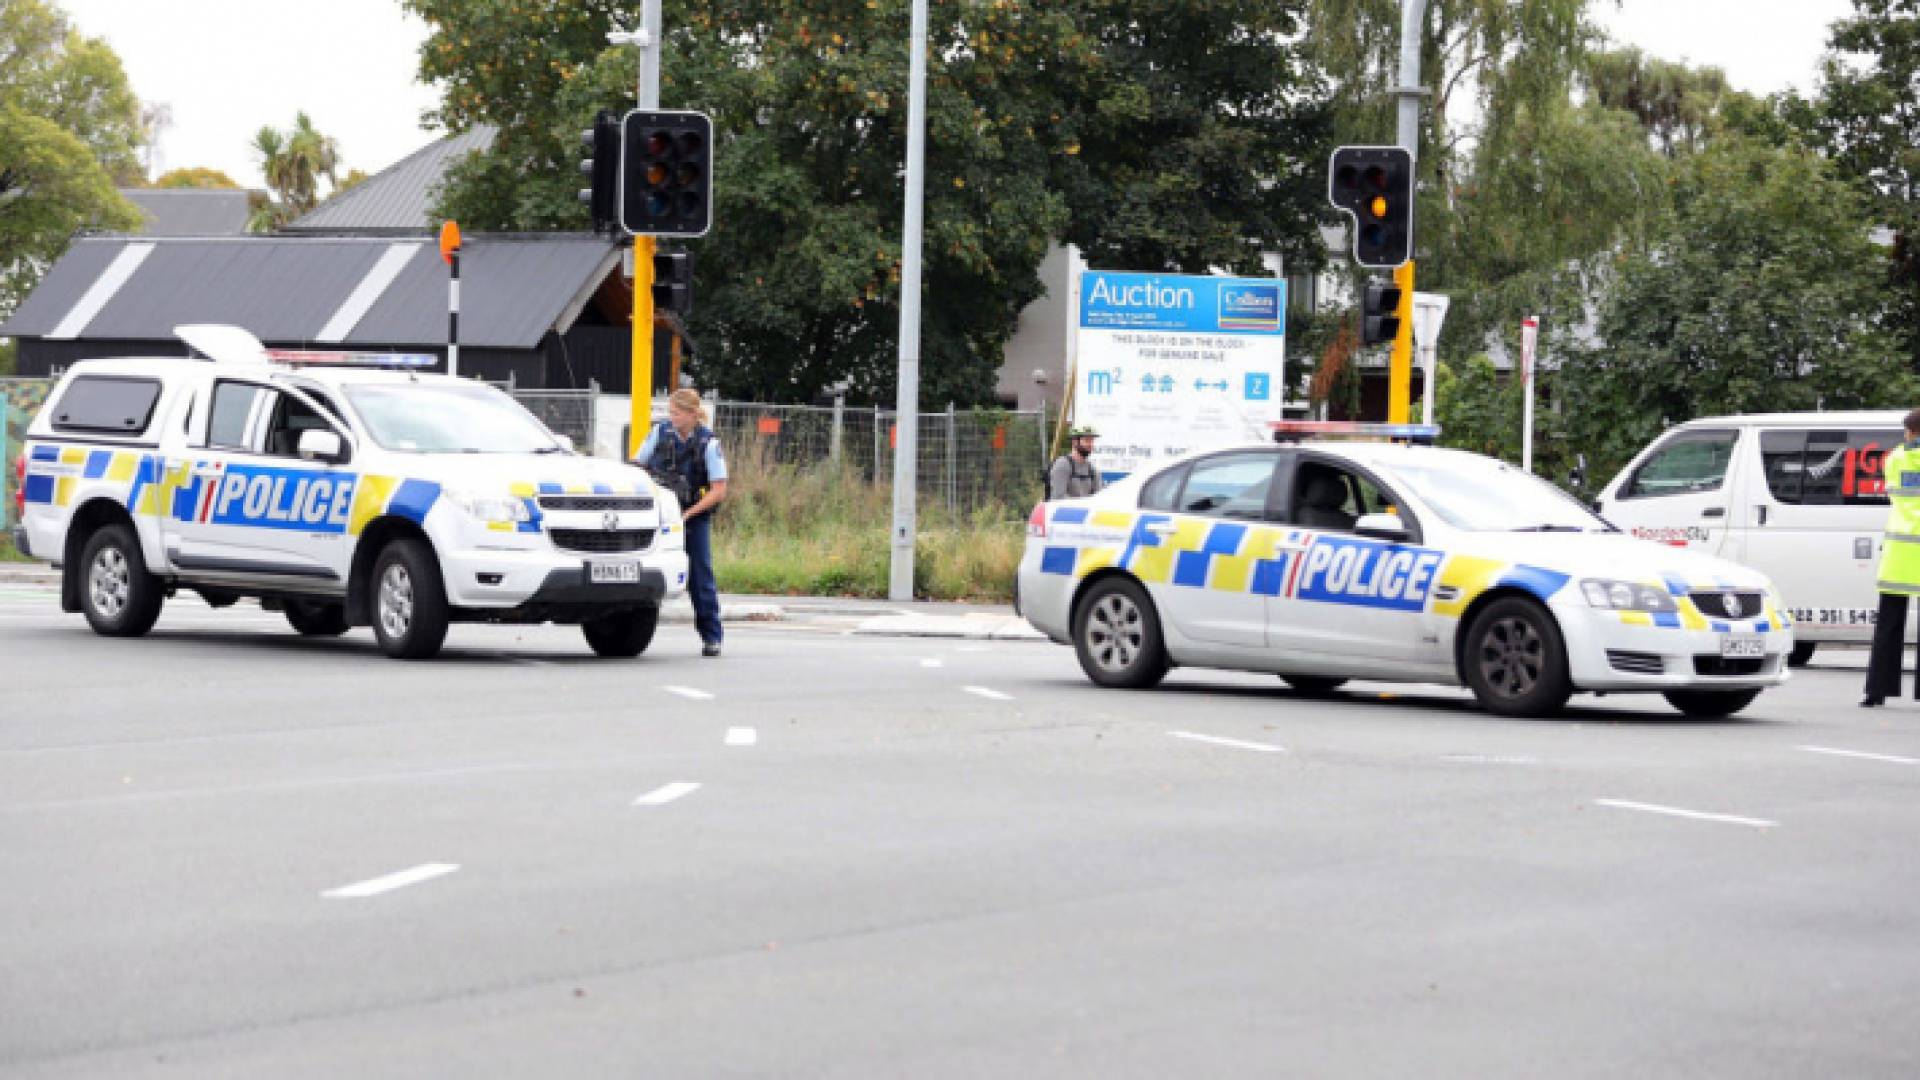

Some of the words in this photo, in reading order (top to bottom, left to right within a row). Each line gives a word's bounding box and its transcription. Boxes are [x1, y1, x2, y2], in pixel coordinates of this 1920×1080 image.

[1088, 277, 1195, 309] Auction
[1112, 334, 1133, 344] THIS
[1196, 338, 1213, 348] THE
[218, 471, 352, 525] POLICE
[1301, 543, 1441, 600] POLICE
